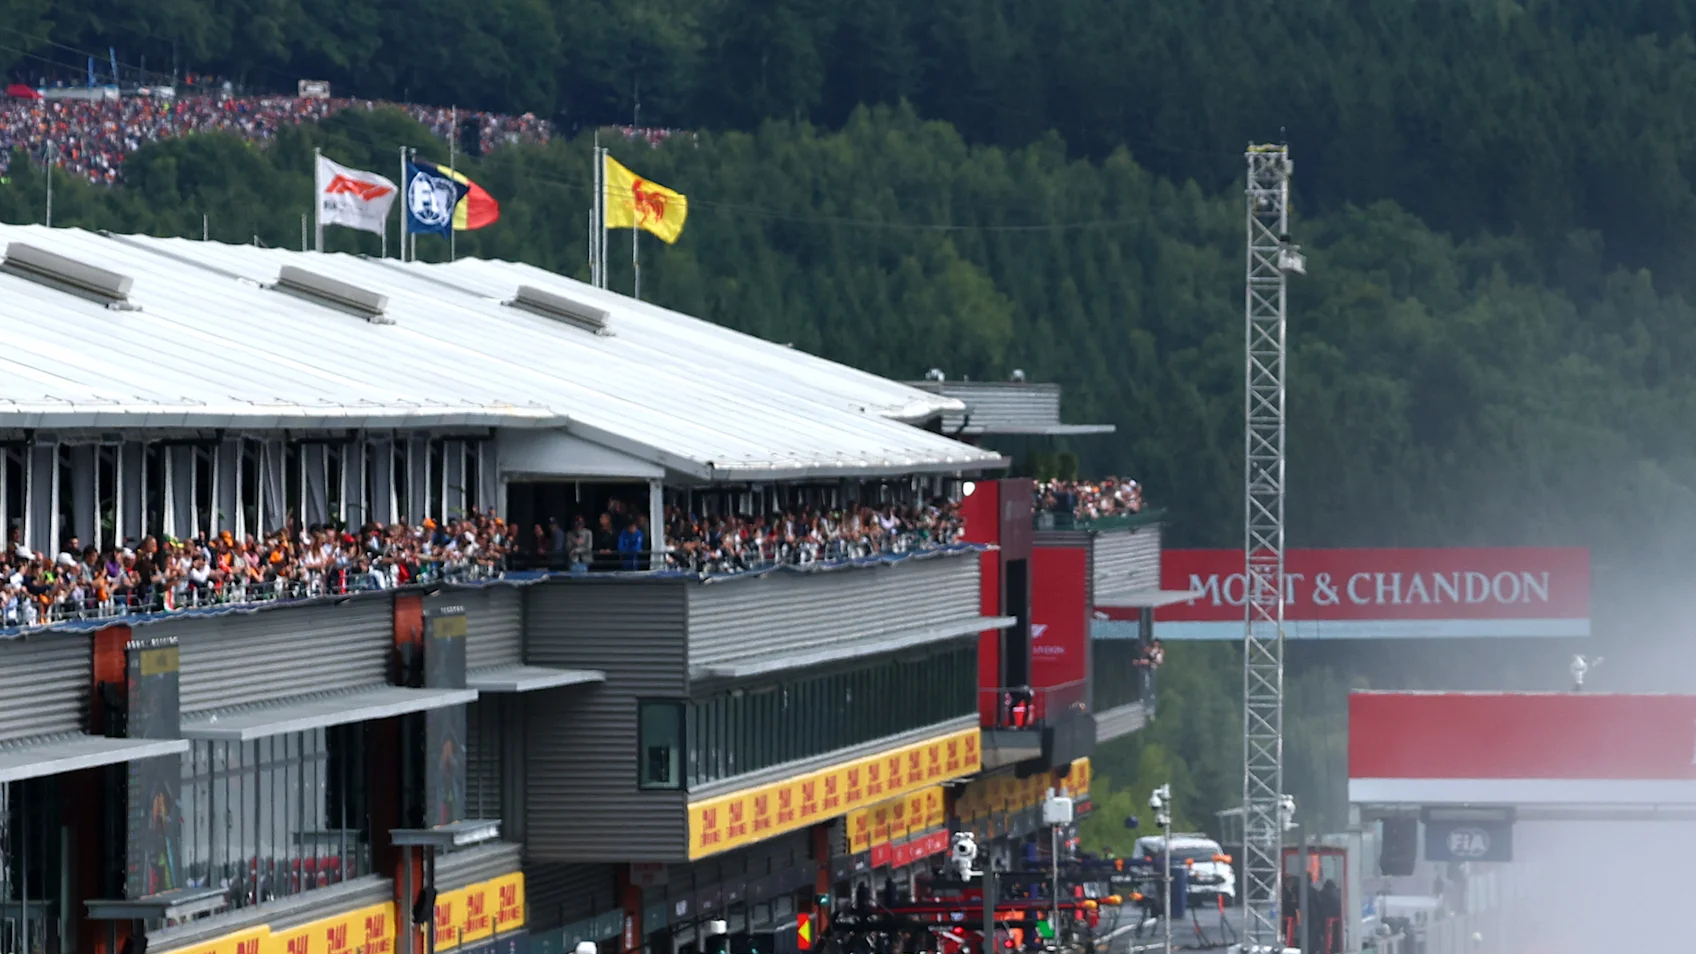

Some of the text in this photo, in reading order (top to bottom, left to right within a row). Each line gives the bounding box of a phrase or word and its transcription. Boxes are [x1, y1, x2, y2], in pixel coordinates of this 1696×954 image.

[1313, 572, 1340, 606] &
[1347, 571, 1550, 606] CHANDON
[1451, 833, 1486, 849] FIA
